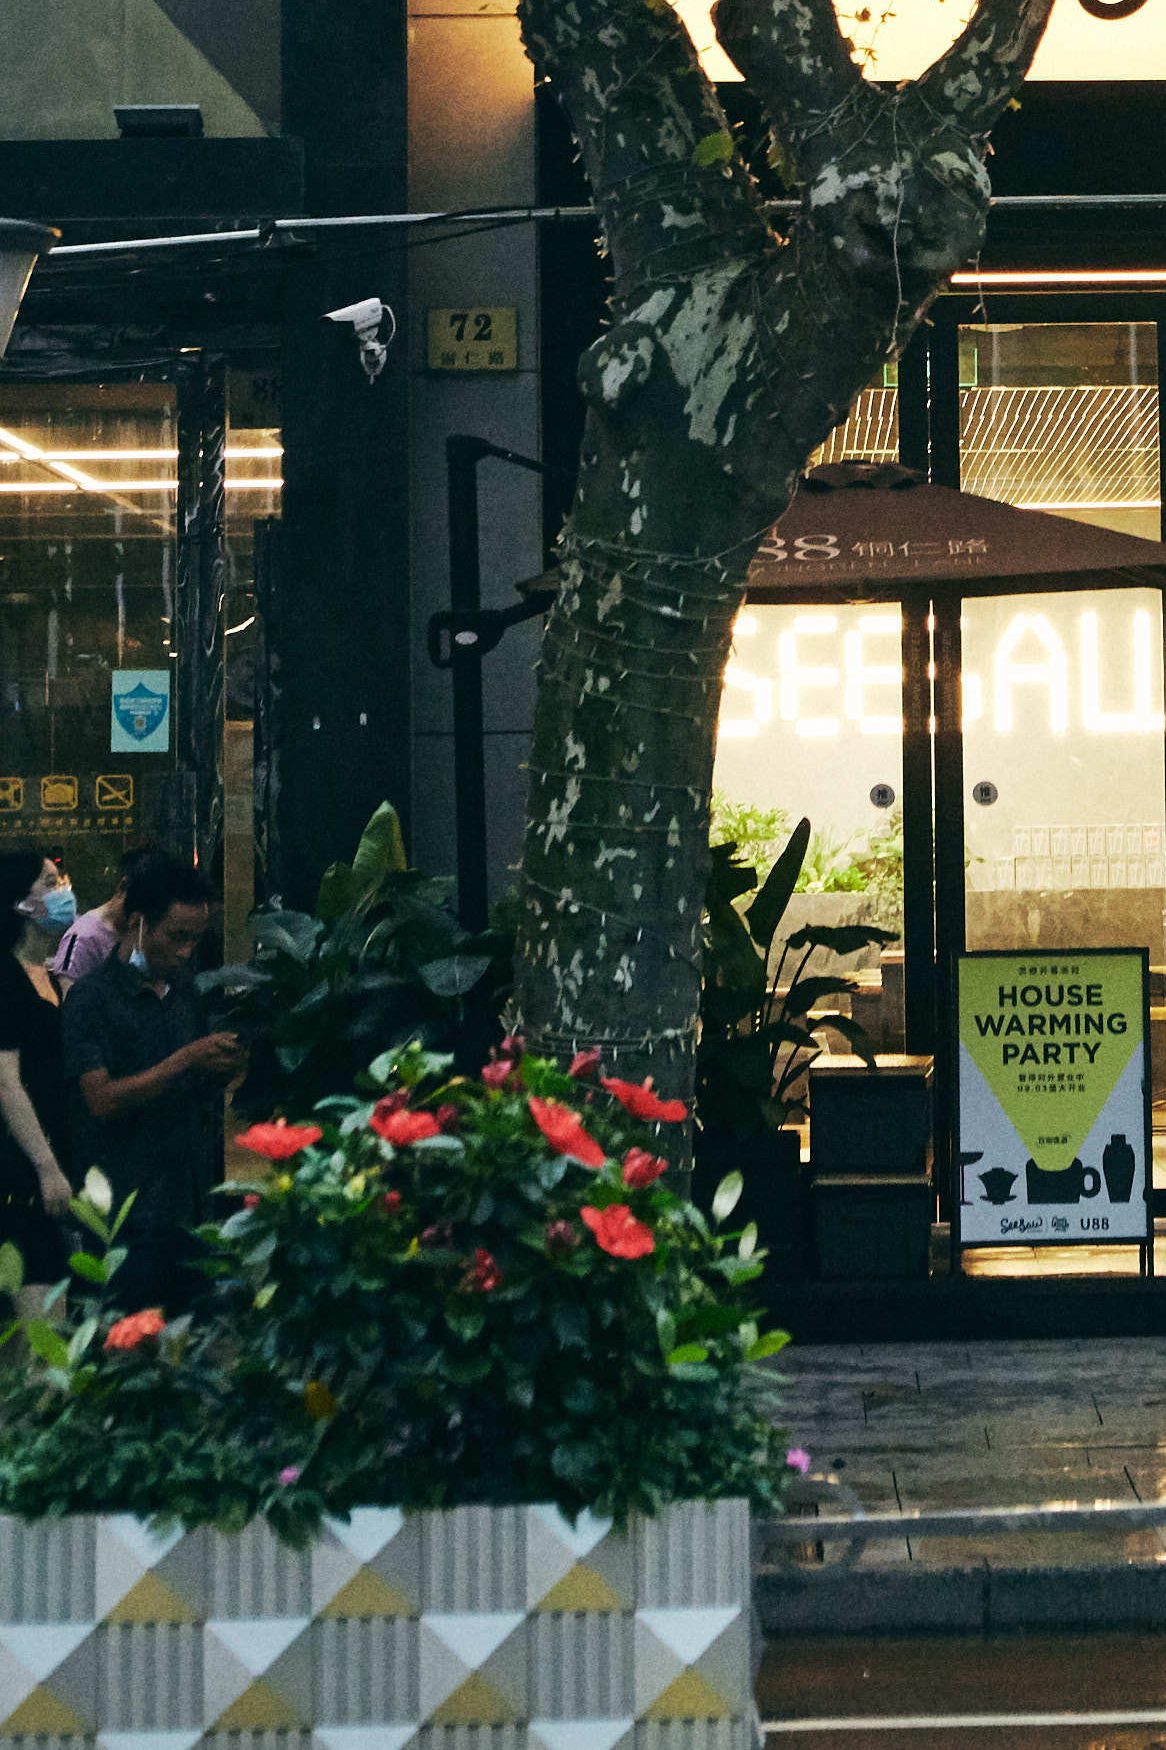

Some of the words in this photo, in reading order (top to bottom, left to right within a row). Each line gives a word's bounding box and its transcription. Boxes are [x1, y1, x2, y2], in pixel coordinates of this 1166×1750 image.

[449, 313, 492, 342] 72
[998, 984, 1103, 1007] HOUSE
[974, 1013, 1128, 1037] WARMING
[1002, 1042, 1102, 1065] PARTY
[1080, 1217, 1110, 1231] U88
